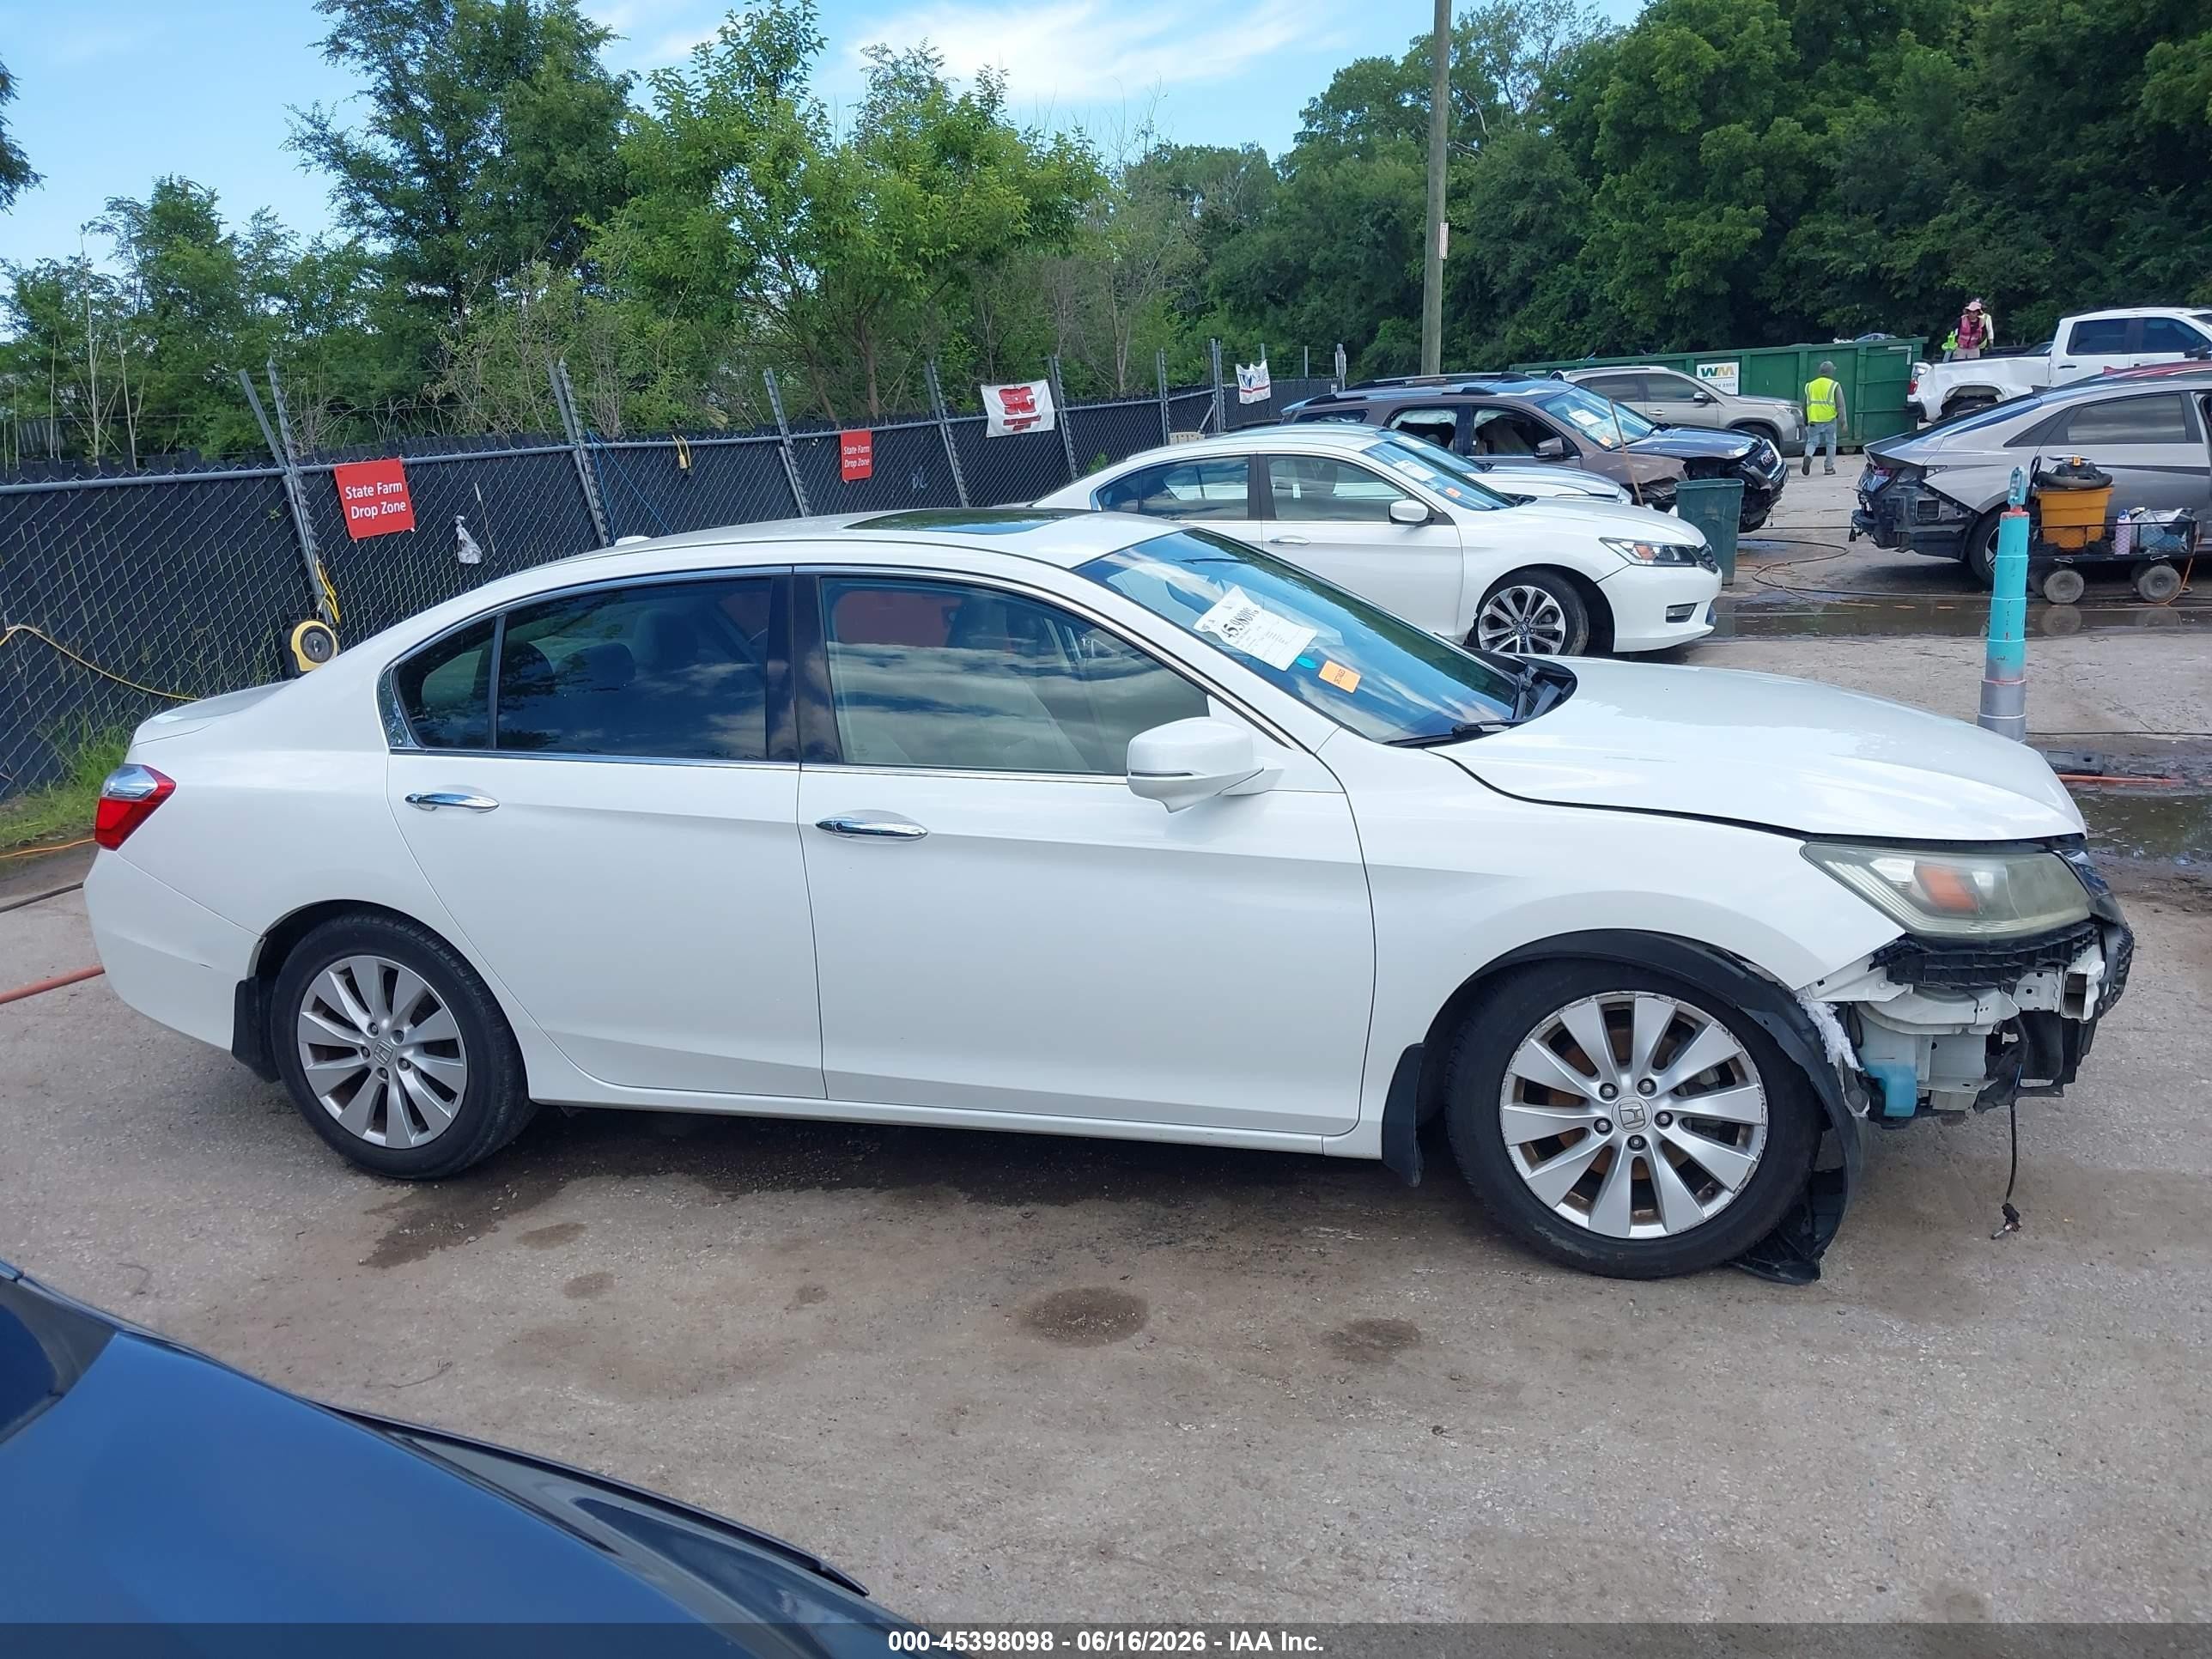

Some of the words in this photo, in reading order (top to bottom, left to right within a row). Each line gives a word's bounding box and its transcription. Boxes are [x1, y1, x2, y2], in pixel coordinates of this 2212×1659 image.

[1700, 366, 1735, 377] WM
[843, 446, 856, 456] State
[858, 445, 871, 455] Farm
[844, 458, 857, 470] Drop
[858, 456, 871, 467] Zone
[345, 484, 374, 501] State
[376, 481, 403, 496] Farm
[351, 502, 379, 521] Drop
[381, 499, 407, 515] Zone
